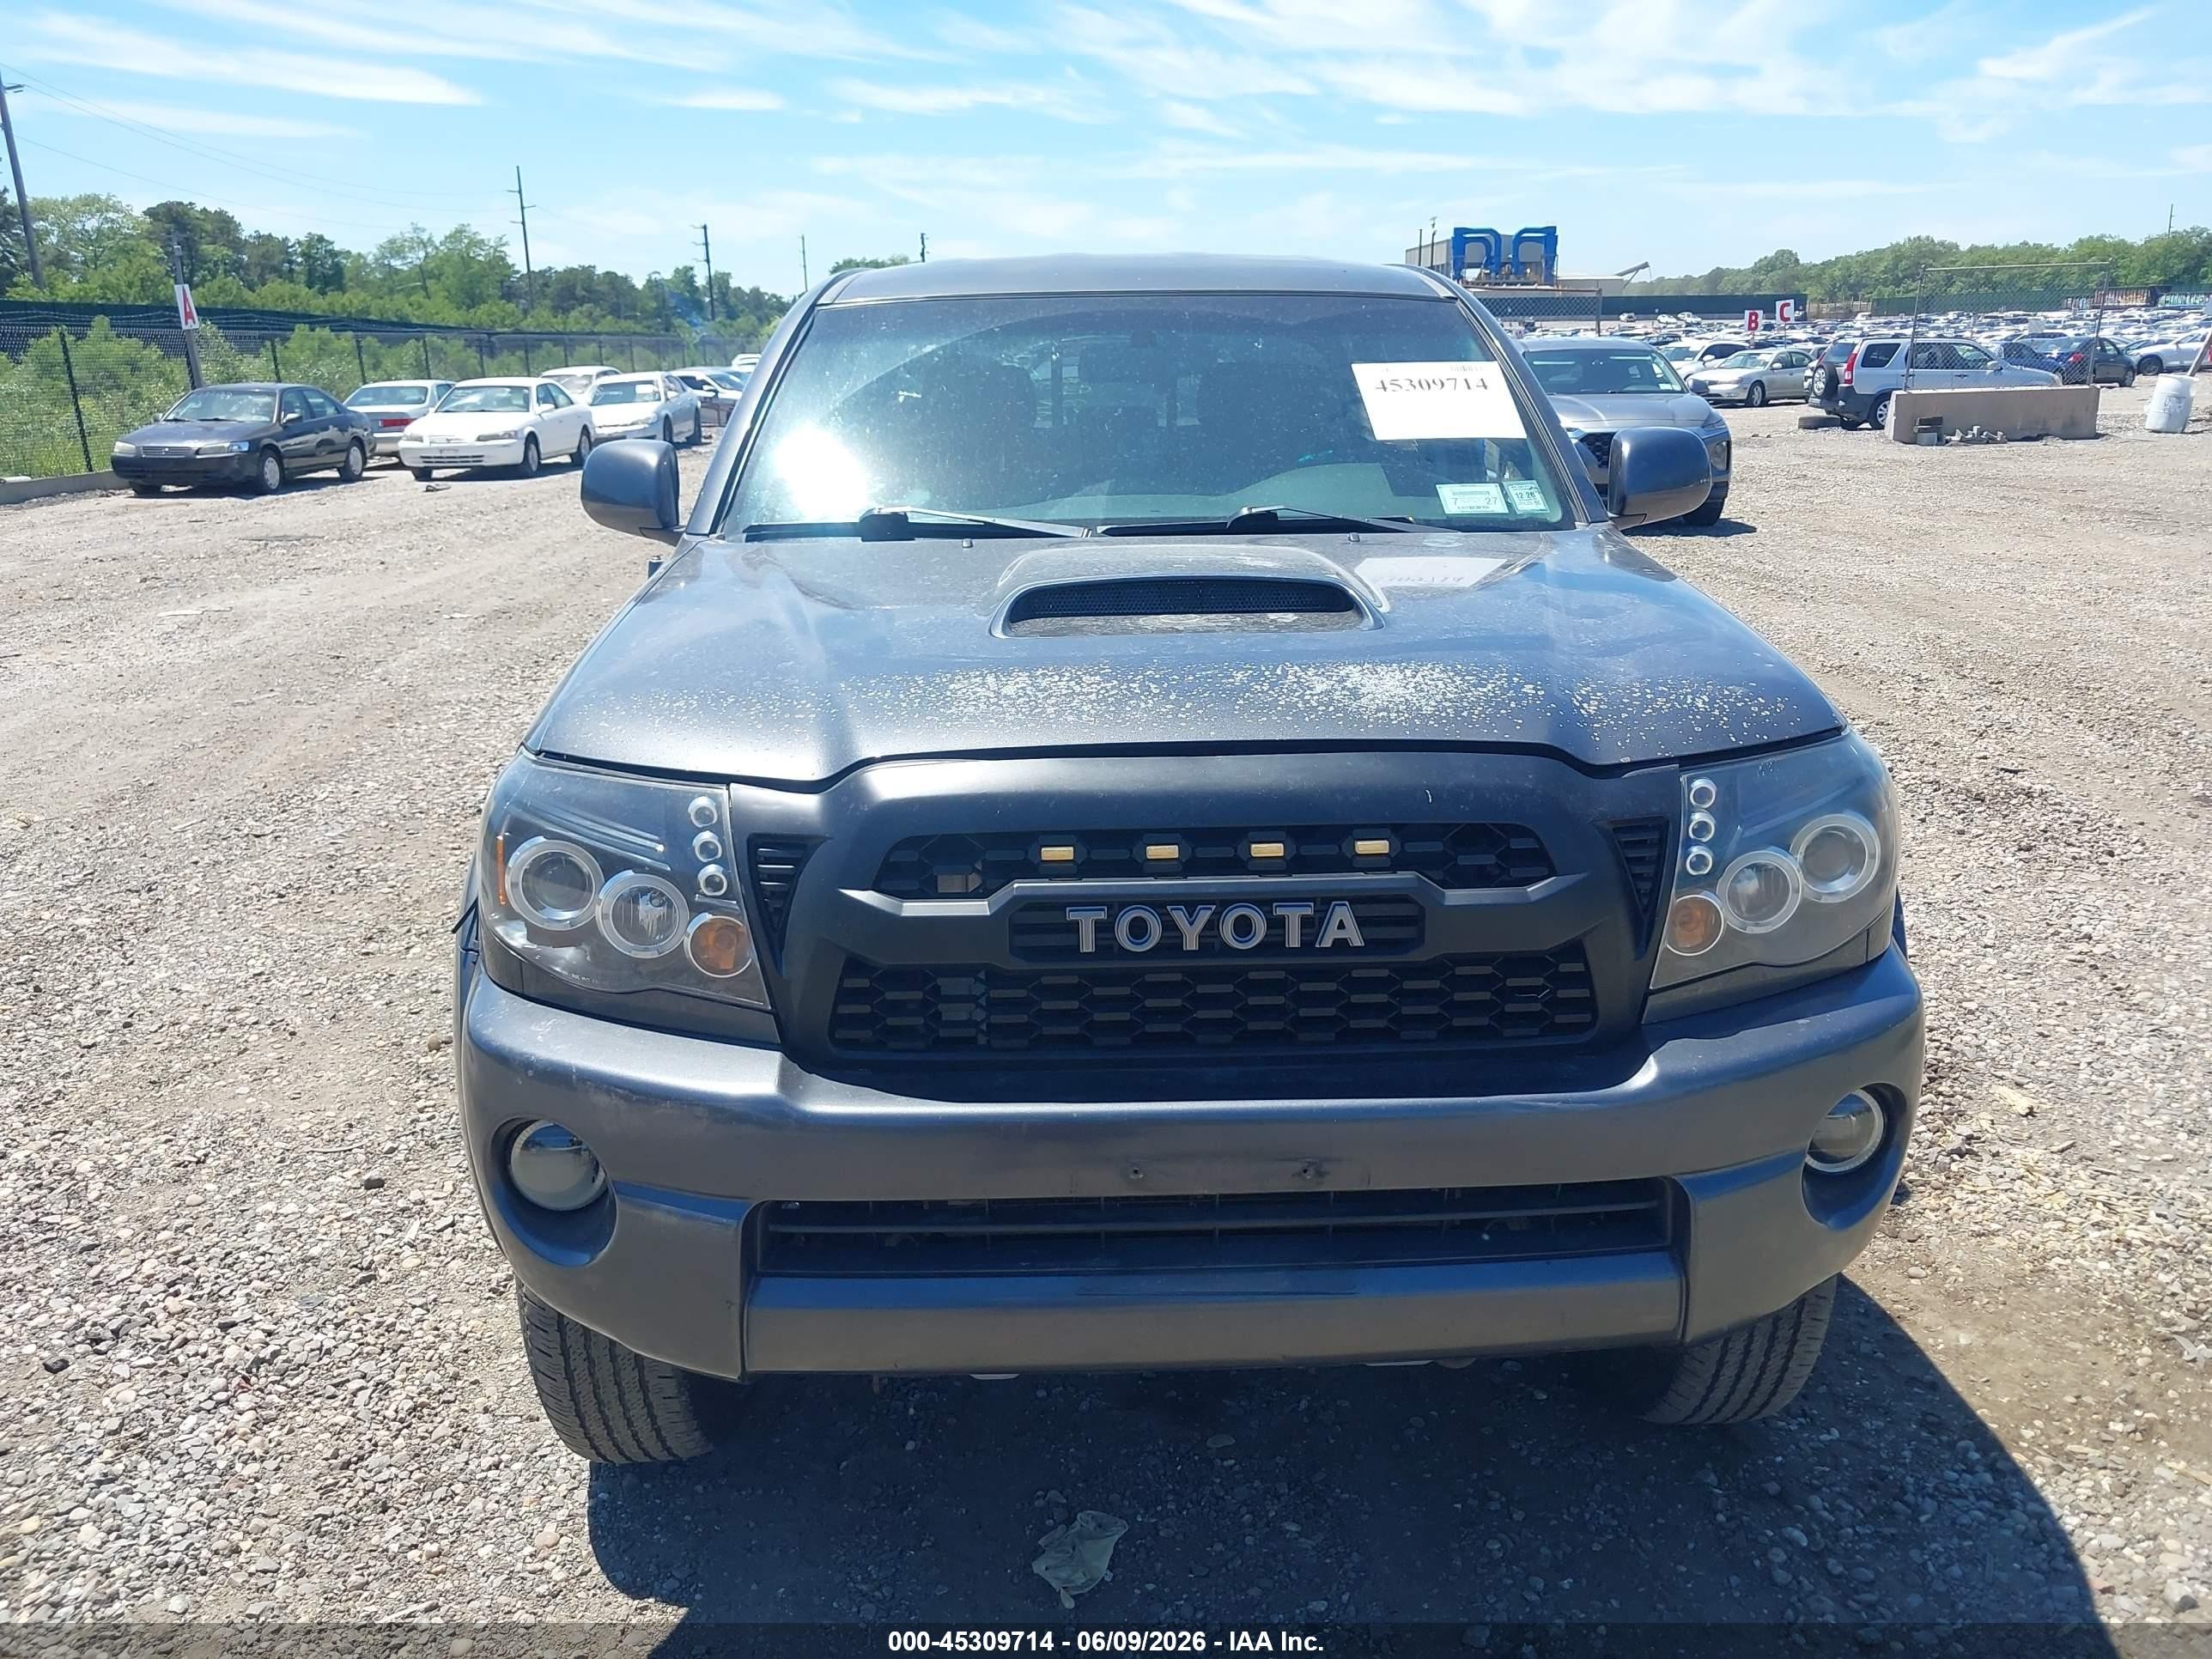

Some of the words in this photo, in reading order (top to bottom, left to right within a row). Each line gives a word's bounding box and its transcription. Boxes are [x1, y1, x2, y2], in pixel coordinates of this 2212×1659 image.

[182, 285, 196, 325] A
[1779, 302, 1791, 322] C
[1747, 311, 1759, 331] B
[1375, 377, 1489, 392] 45309714
[1066, 900, 1365, 953] TOYOTA
